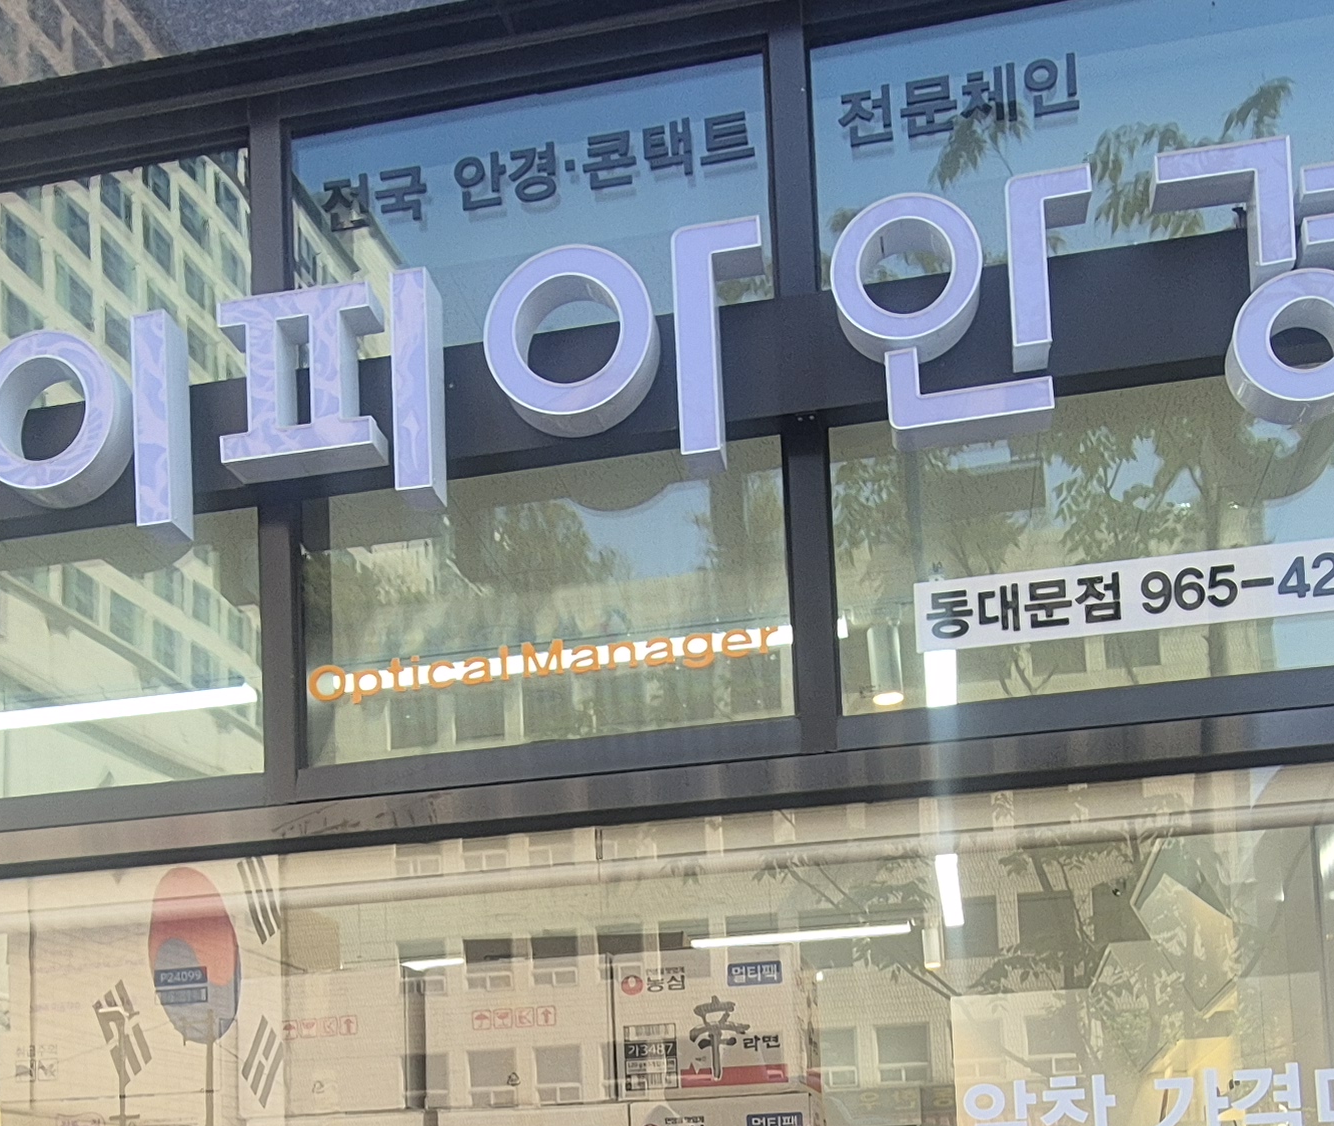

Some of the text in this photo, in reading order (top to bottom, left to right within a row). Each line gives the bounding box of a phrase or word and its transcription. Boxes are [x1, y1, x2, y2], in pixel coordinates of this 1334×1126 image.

[838, 53, 1080, 148] 전문체인
[320, 164, 428, 232] 전국
[925, 573, 1124, 640] 동대문점
[160, 969, 202, 983] P24099
[646, 975, 685, 992] 농심
[731, 963, 778, 983] 멀티팩
[689, 995, 751, 1079] 辛
[743, 1034, 781, 1052] 라면
